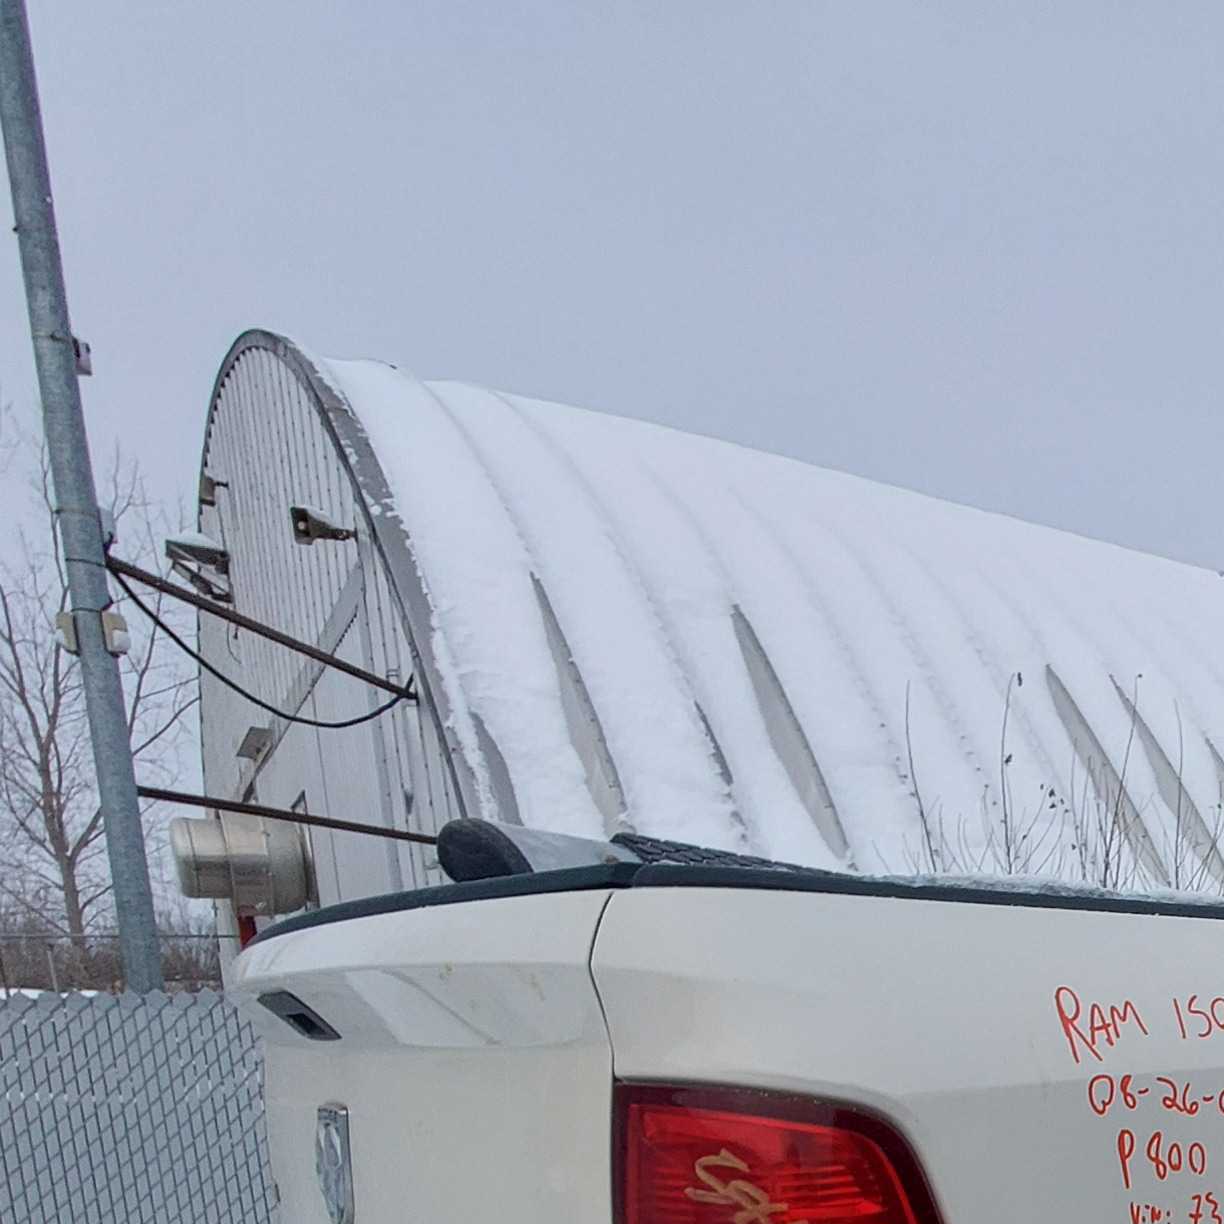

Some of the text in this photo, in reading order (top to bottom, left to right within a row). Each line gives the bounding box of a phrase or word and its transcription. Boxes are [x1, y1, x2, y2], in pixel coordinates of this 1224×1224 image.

[1055, 986, 1149, 1063] RAM
[1117, 1128, 1206, 1190] P 800
